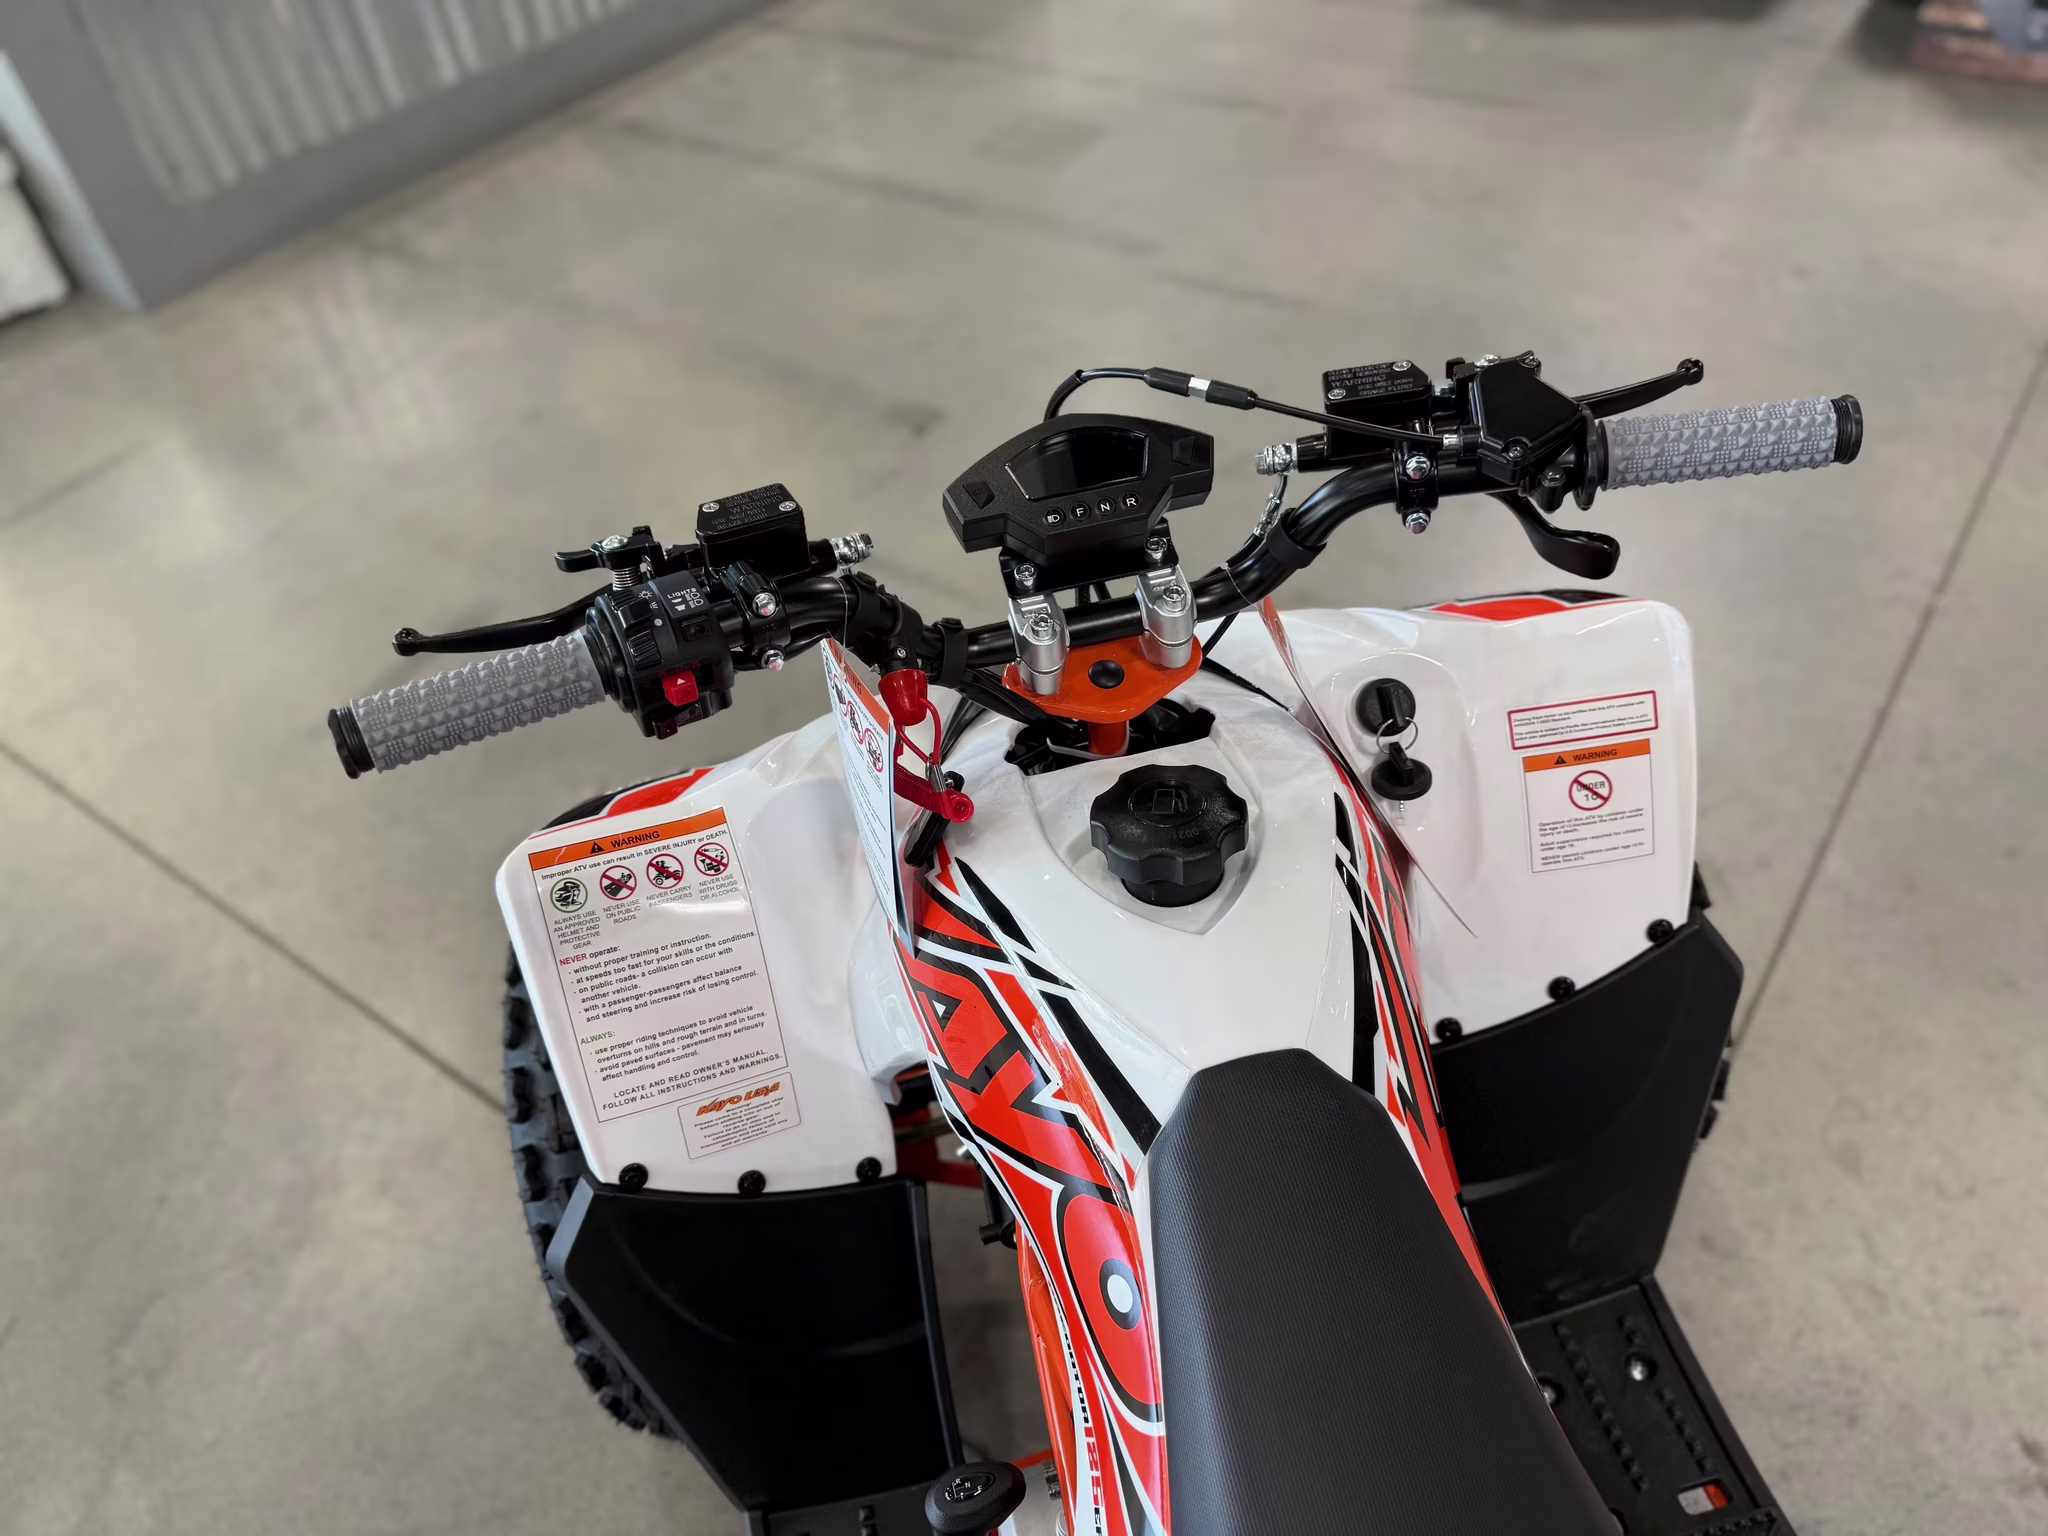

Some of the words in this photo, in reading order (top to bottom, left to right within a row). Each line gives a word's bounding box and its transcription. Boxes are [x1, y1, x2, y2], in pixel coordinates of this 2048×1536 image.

[1076, 507, 1085, 517] F
[1101, 502, 1111, 512] N
[1126, 497, 1136, 507] R
[667, 587, 697, 599] LIGHTS
[1572, 748, 1617, 761] WARNING
[610, 829, 660, 849] WARNING
[541, 867, 573, 881] Improper
[572, 863, 587, 872] ATV
[615, 853, 635, 862] result
[643, 843, 671, 855] SEVERE
[672, 838, 696, 848] INJURY
[705, 829, 728, 840] DEATH.
[698, 877, 720, 887] NEVER
[721, 873, 734, 881] USE
[698, 885, 715, 894] WITH
[715, 879, 738, 890] DRUGS
[646, 890, 668, 901] NEVER
[669, 884, 692, 895] CARRY
[648, 891, 693, 908] PASSENGERS
[699, 893, 710, 901] OR
[710, 885, 740, 898] ALCOHOL
[602, 902, 625, 913] NEVER
[626, 898, 640, 906] USE
[605, 911, 616, 919] ON
[616, 905, 640, 916] PUBLIC
[553, 913, 581, 925] ALWAYS
[582, 909, 596, 918] USE
[564, 916, 600, 930] APPROVED
[613, 913, 636, 924] ROADS
[557, 927, 584, 939] HELMET
[585, 923, 600, 932] AND
[559, 930, 600, 946] PROTECTIVE
[559, 952, 587, 966] NEVER
[588, 944, 620, 959] operate:
[572, 940, 592, 950] GEAR
[573, 960, 602, 974] without
[603, 955, 629, 967] proper
[629, 946, 659, 960] training
[669, 931, 711, 948] instruction.
[575, 976, 583, 984] at
[584, 968, 612, 982] speeds
[613, 965, 626, 974] too
[627, 960, 642, 970] fast
[642, 957, 654, 966] for
[655, 953, 673, 963] your
[673, 946, 693, 957] skills
[704, 940, 716, 949] the
[717, 930, 756, 945] conditions.
[589, 978, 614, 992] public
[646, 961, 679, 975] collision
[680, 958, 694, 966] can
[695, 952, 716, 962] occur
[717, 946, 733, 955] with
[580, 990, 610, 1003] another
[611, 982, 640, 995] vehicle.
[583, 1003, 599, 1012] with
[691, 972, 713, 983] affect
[714, 964, 742, 977] balance
[585, 1013, 600, 1022] and
[601, 1004, 632, 1020] steering
[633, 1000, 648, 1009] and
[649, 991, 681, 1005] increase
[682, 986, 696, 996] risk
[706, 977, 730, 990] losing
[730, 969, 758, 982] control.
[579, 1029, 615, 1045] ALWAYS:
[594, 1046, 608, 1055] use
[609, 1039, 634, 1052] proper
[635, 1032, 657, 1044] riding
[657, 1020, 697, 1038] techniques
[707, 1012, 727, 1023] avoid
[728, 1004, 753, 1016] vehicle
[596, 1049, 632, 1064] overturns
[633, 1046, 643, 1054] on
[644, 1041, 660, 1050] hills
[661, 1036, 675, 1046] and
[676, 1030, 698, 1042] rough
[699, 1023, 722, 1035] terrain
[723, 1018, 737, 1027] and
[746, 1010, 766, 1020] turns.
[599, 1062, 619, 1073] avoid
[620, 1055, 643, 1068] paved
[644, 1046, 675, 1060] surfaces
[681, 1035, 716, 1050] pavement
[716, 1031, 732, 1040] may
[732, 1020, 765, 1035] seriously
[601, 1070, 622, 1081] affect
[623, 1061, 656, 1077] handling
[656, 1057, 670, 1066] and
[671, 1049, 699, 1062] control.
[613, 1083, 646, 1098] LOCATE
[647, 1078, 666, 1088] AND
[668, 1071, 690, 1082] READ
[692, 1059, 730, 1075] OWNER'S
[732, 1048, 767, 1063] MANUAL.
[602, 1094, 638, 1111] FOLLOW
[638, 1090, 655, 1100] ALL
[657, 1072, 717, 1095] INSTRUCTIONS
[718, 1066, 736, 1076] AND
[737, 1052, 782, 1070] WARNINGS.
[695, 1095, 743, 1117] KAYO
